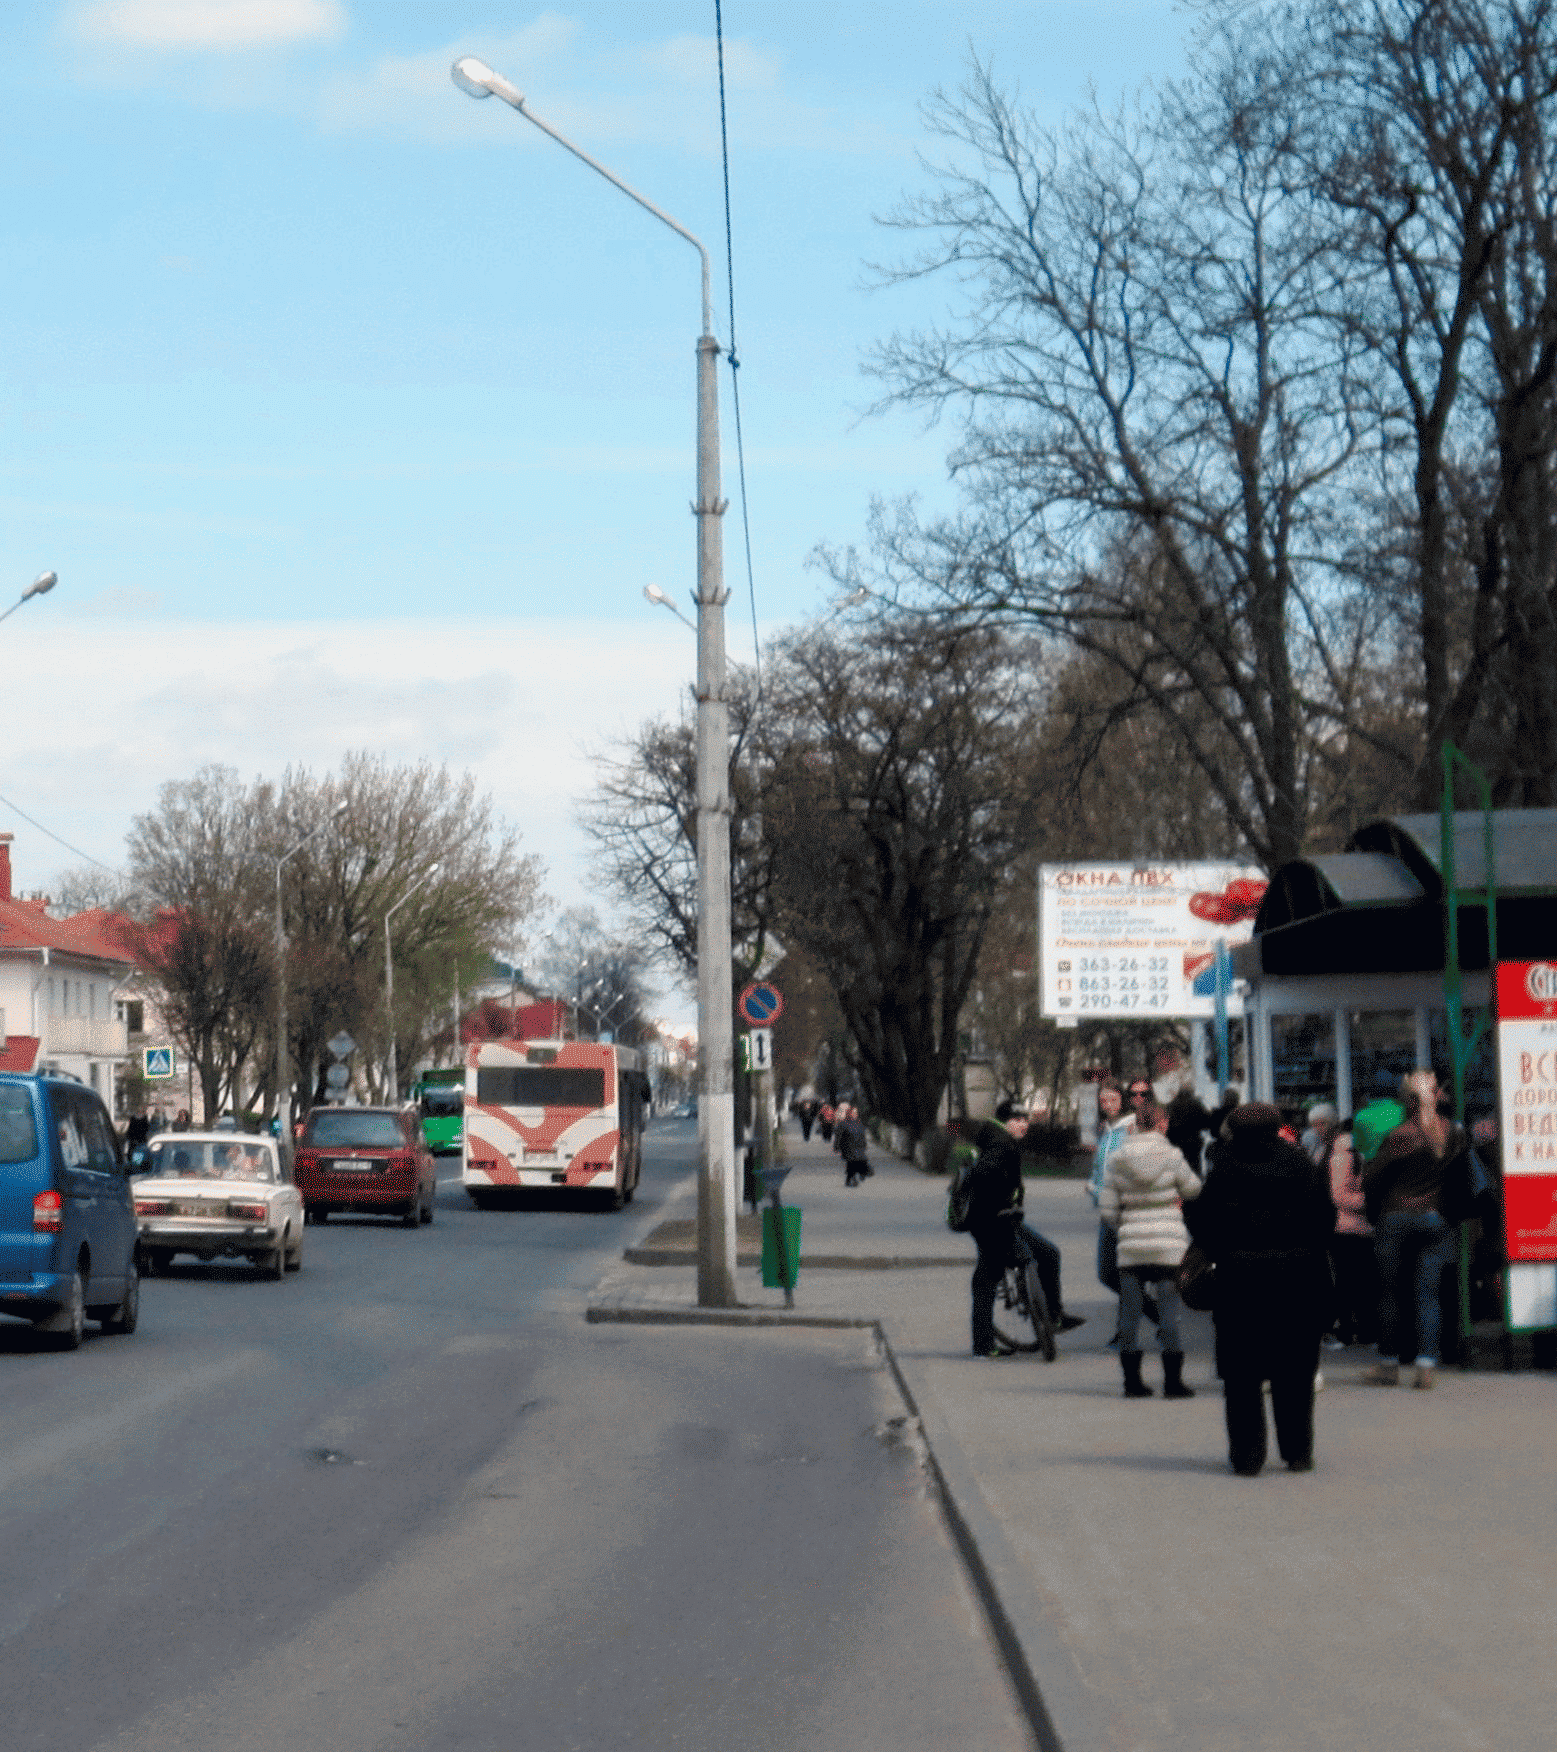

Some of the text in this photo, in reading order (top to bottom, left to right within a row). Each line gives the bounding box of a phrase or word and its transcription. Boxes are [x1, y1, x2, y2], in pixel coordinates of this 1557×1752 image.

[1056, 868, 1174, 887] ОКНА ПВХ
[1079, 956, 1169, 972] 363-26-32
[1079, 976, 1169, 991] 863-26-32
[1079, 994, 1169, 1009] 290-47-47
